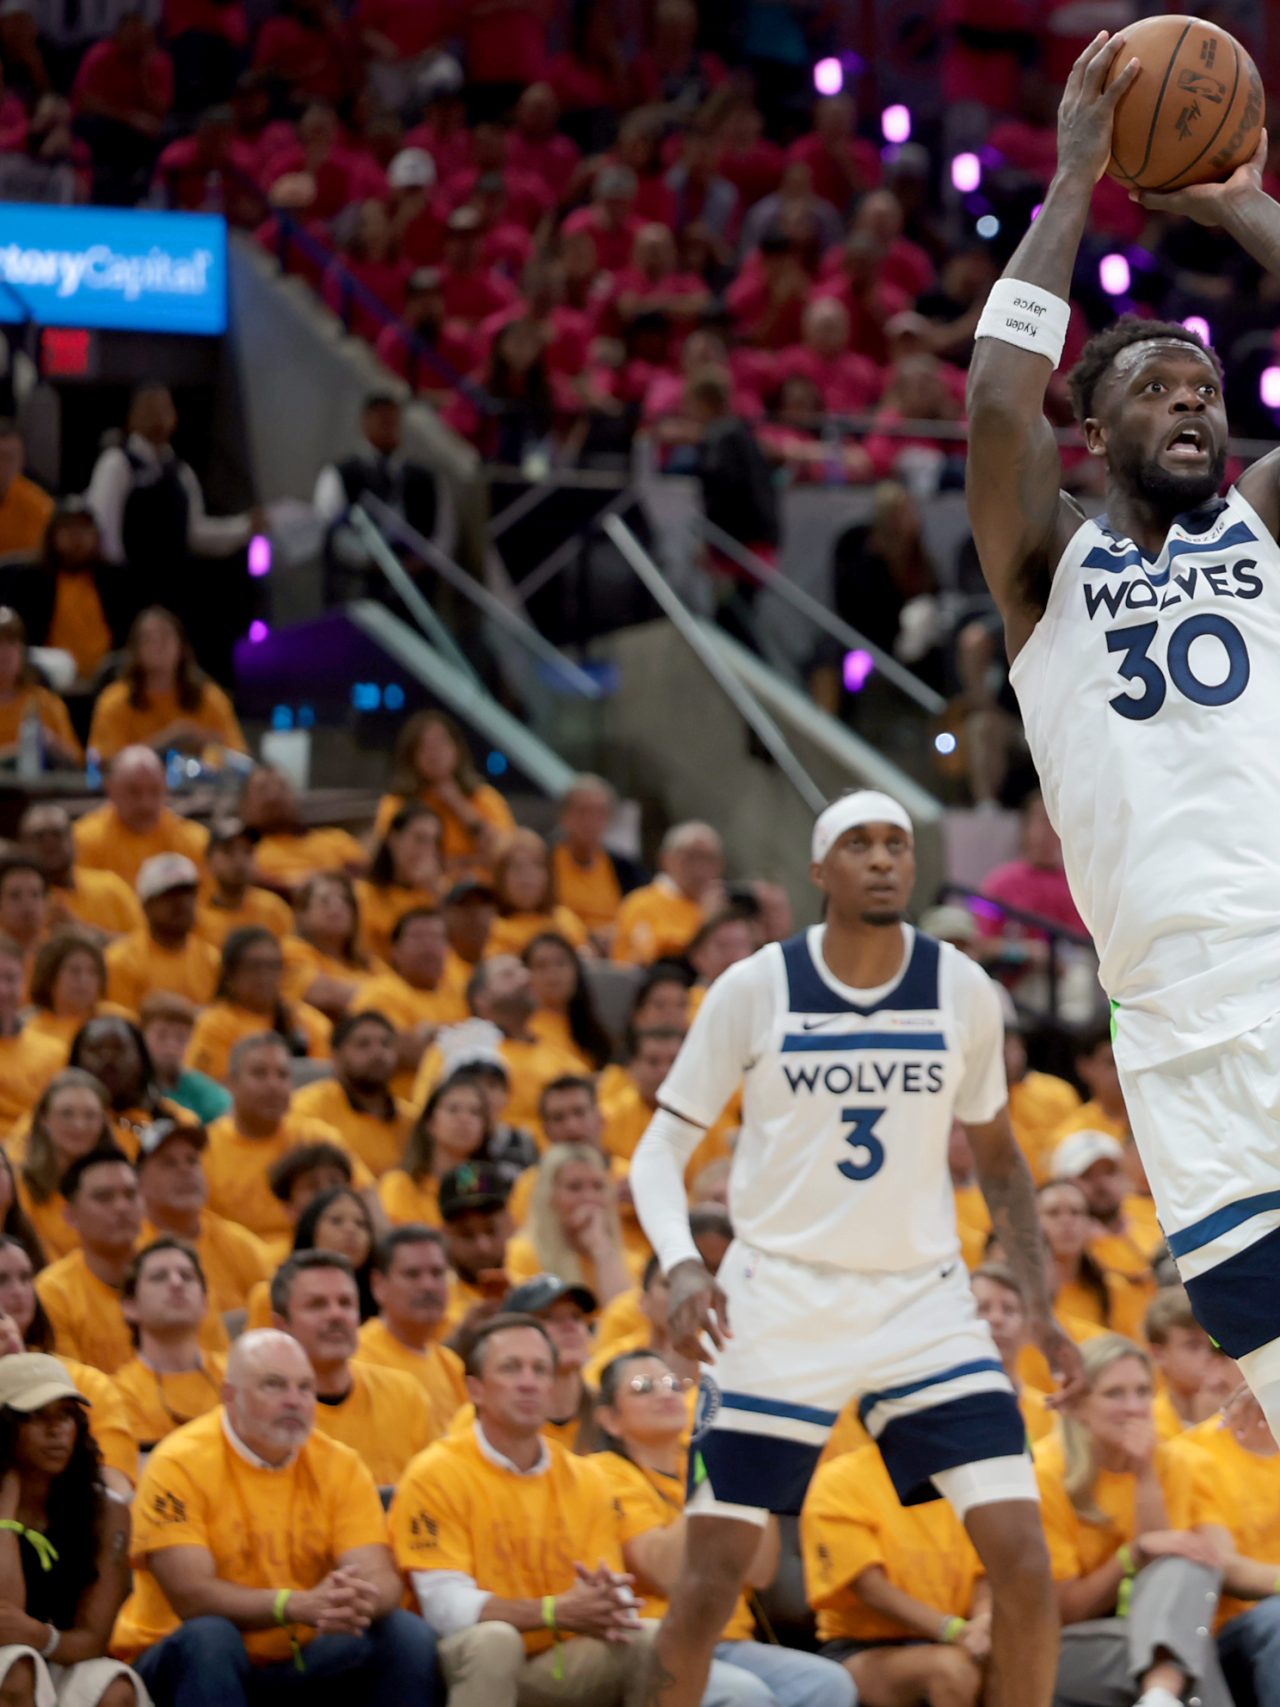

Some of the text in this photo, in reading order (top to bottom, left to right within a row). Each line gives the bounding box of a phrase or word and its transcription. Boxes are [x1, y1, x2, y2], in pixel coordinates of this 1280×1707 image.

[1005, 318, 1039, 337] Kyden
[1013, 297, 1047, 317] Jayce
[1083, 559, 1264, 621] WOLVES
[1105, 613, 1250, 721] 30
[783, 1062, 945, 1095] WOLVES
[836, 1106, 887, 1181] 3
